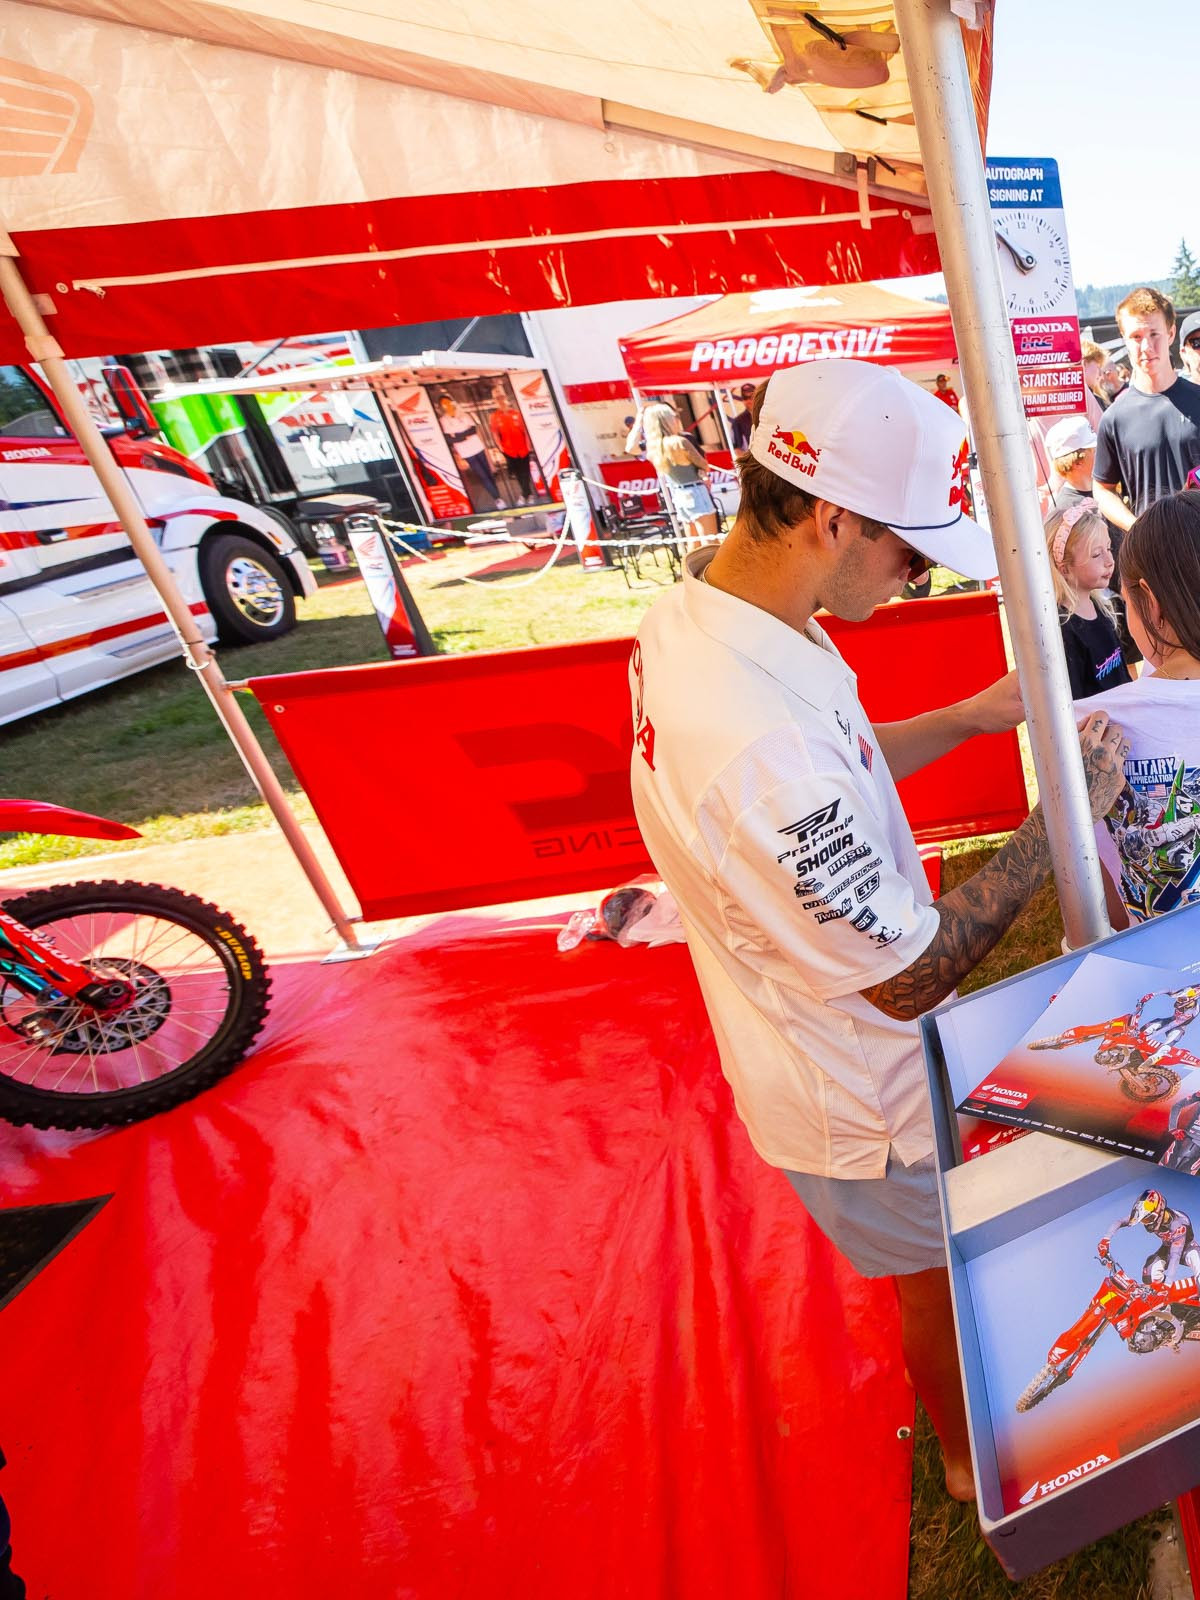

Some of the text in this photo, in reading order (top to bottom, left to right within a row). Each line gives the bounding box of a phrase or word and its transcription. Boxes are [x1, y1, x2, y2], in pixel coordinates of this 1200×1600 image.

[985, 167, 1044, 181] AUTOGRAPH
[989, 188, 1044, 202] SIGNING AT
[1017, 221, 1026, 229] 12
[1013, 322, 1075, 335] HONDA
[690, 326, 893, 372] PROGRESSIVE
[1021, 335, 1053, 351] HRC
[1016, 351, 1071, 365] ROGRESSIVE.
[1022, 371, 1082, 388] STARTS HERE
[1022, 391, 1083, 406] TBAND REQUIRED
[3, 447, 51, 460] HONDA
[767, 441, 817, 478] Red Bull
[1129, 773, 1174, 785] APPRECIATION
[777, 844, 810, 864] Pro
[796, 833, 854, 878] SHOWA
[857, 875, 878, 897] ETS
[814, 907, 842, 924] Twin
[218, 930, 252, 980] DUNLOP
[992, 1086, 1028, 1100] HONDA
[1039, 1454, 1112, 1496] HONDA
